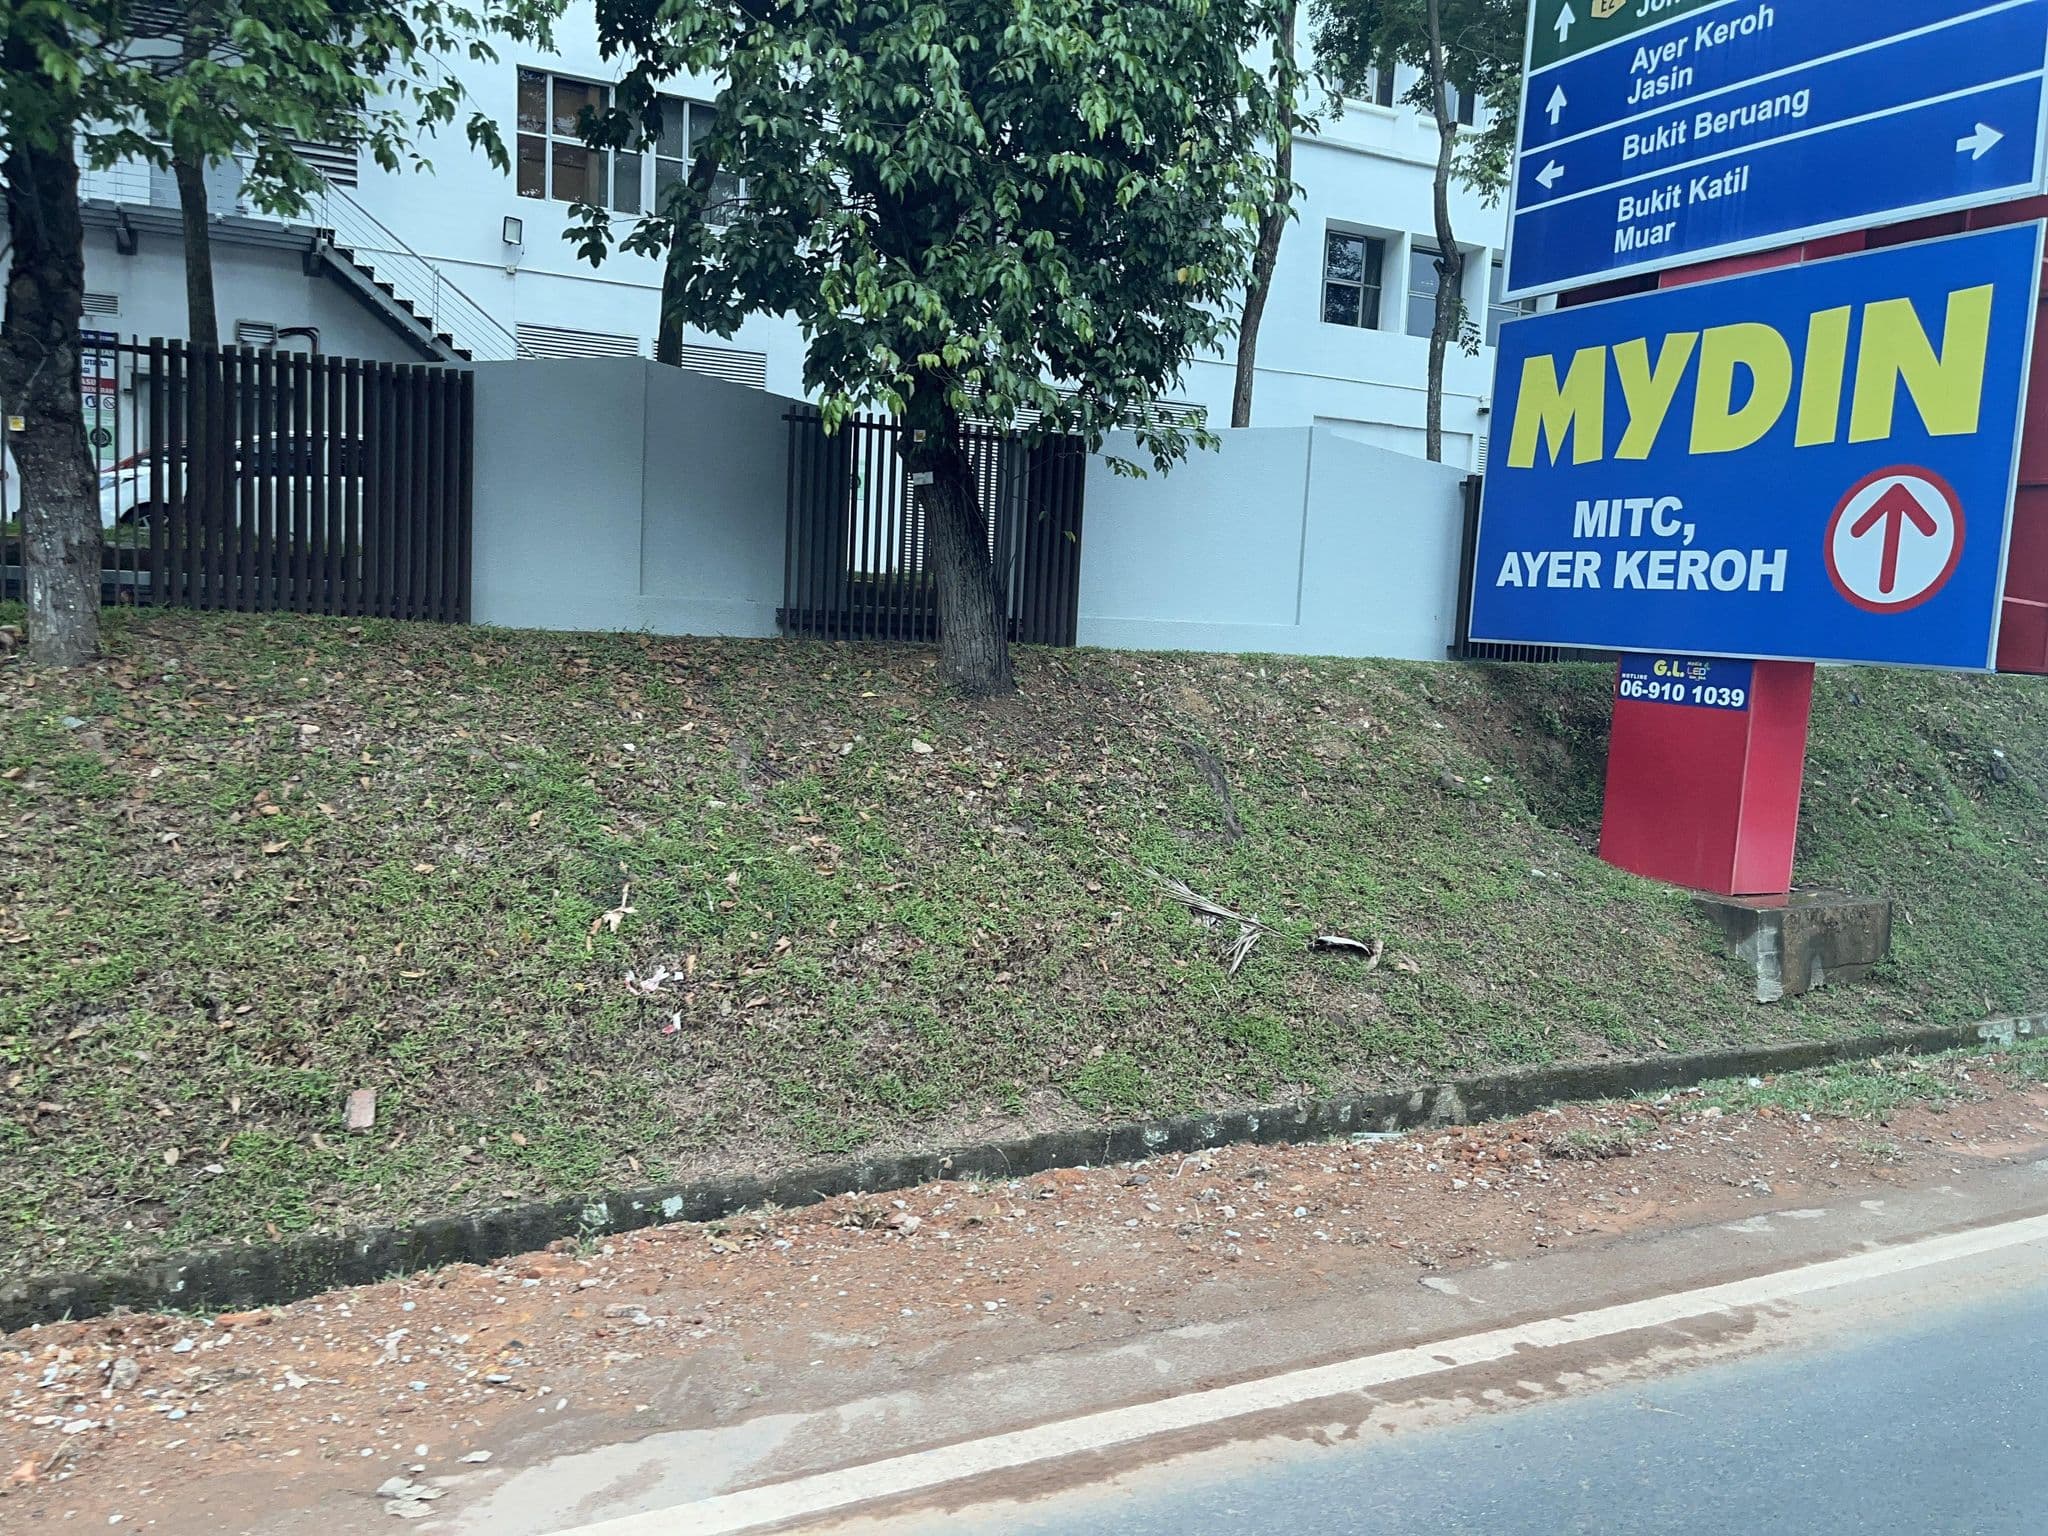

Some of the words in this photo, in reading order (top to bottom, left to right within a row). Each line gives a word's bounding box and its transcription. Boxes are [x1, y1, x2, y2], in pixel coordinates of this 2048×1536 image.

[1630, 36, 1689, 74] Ayer
[1694, 4, 1774, 52] Keroh
[1627, 65, 1693, 105] Jasin
[1622, 119, 1687, 161] Bukit
[1694, 88, 1810, 140] Beruang
[1617, 184, 1682, 223] Bukit
[1688, 165, 1749, 205] Katil
[1614, 221, 1676, 254] Muar
[1506, 283, 1994, 469] MYDIN
[1573, 496, 1695, 546] MITC,
[1495, 551, 1602, 589] AYER
[1613, 549, 1788, 592] KEROH
[1653, 659, 1685, 678] G.L.
[1620, 679, 1685, 702] 06-910
[1692, 685, 1745, 707] 1039
